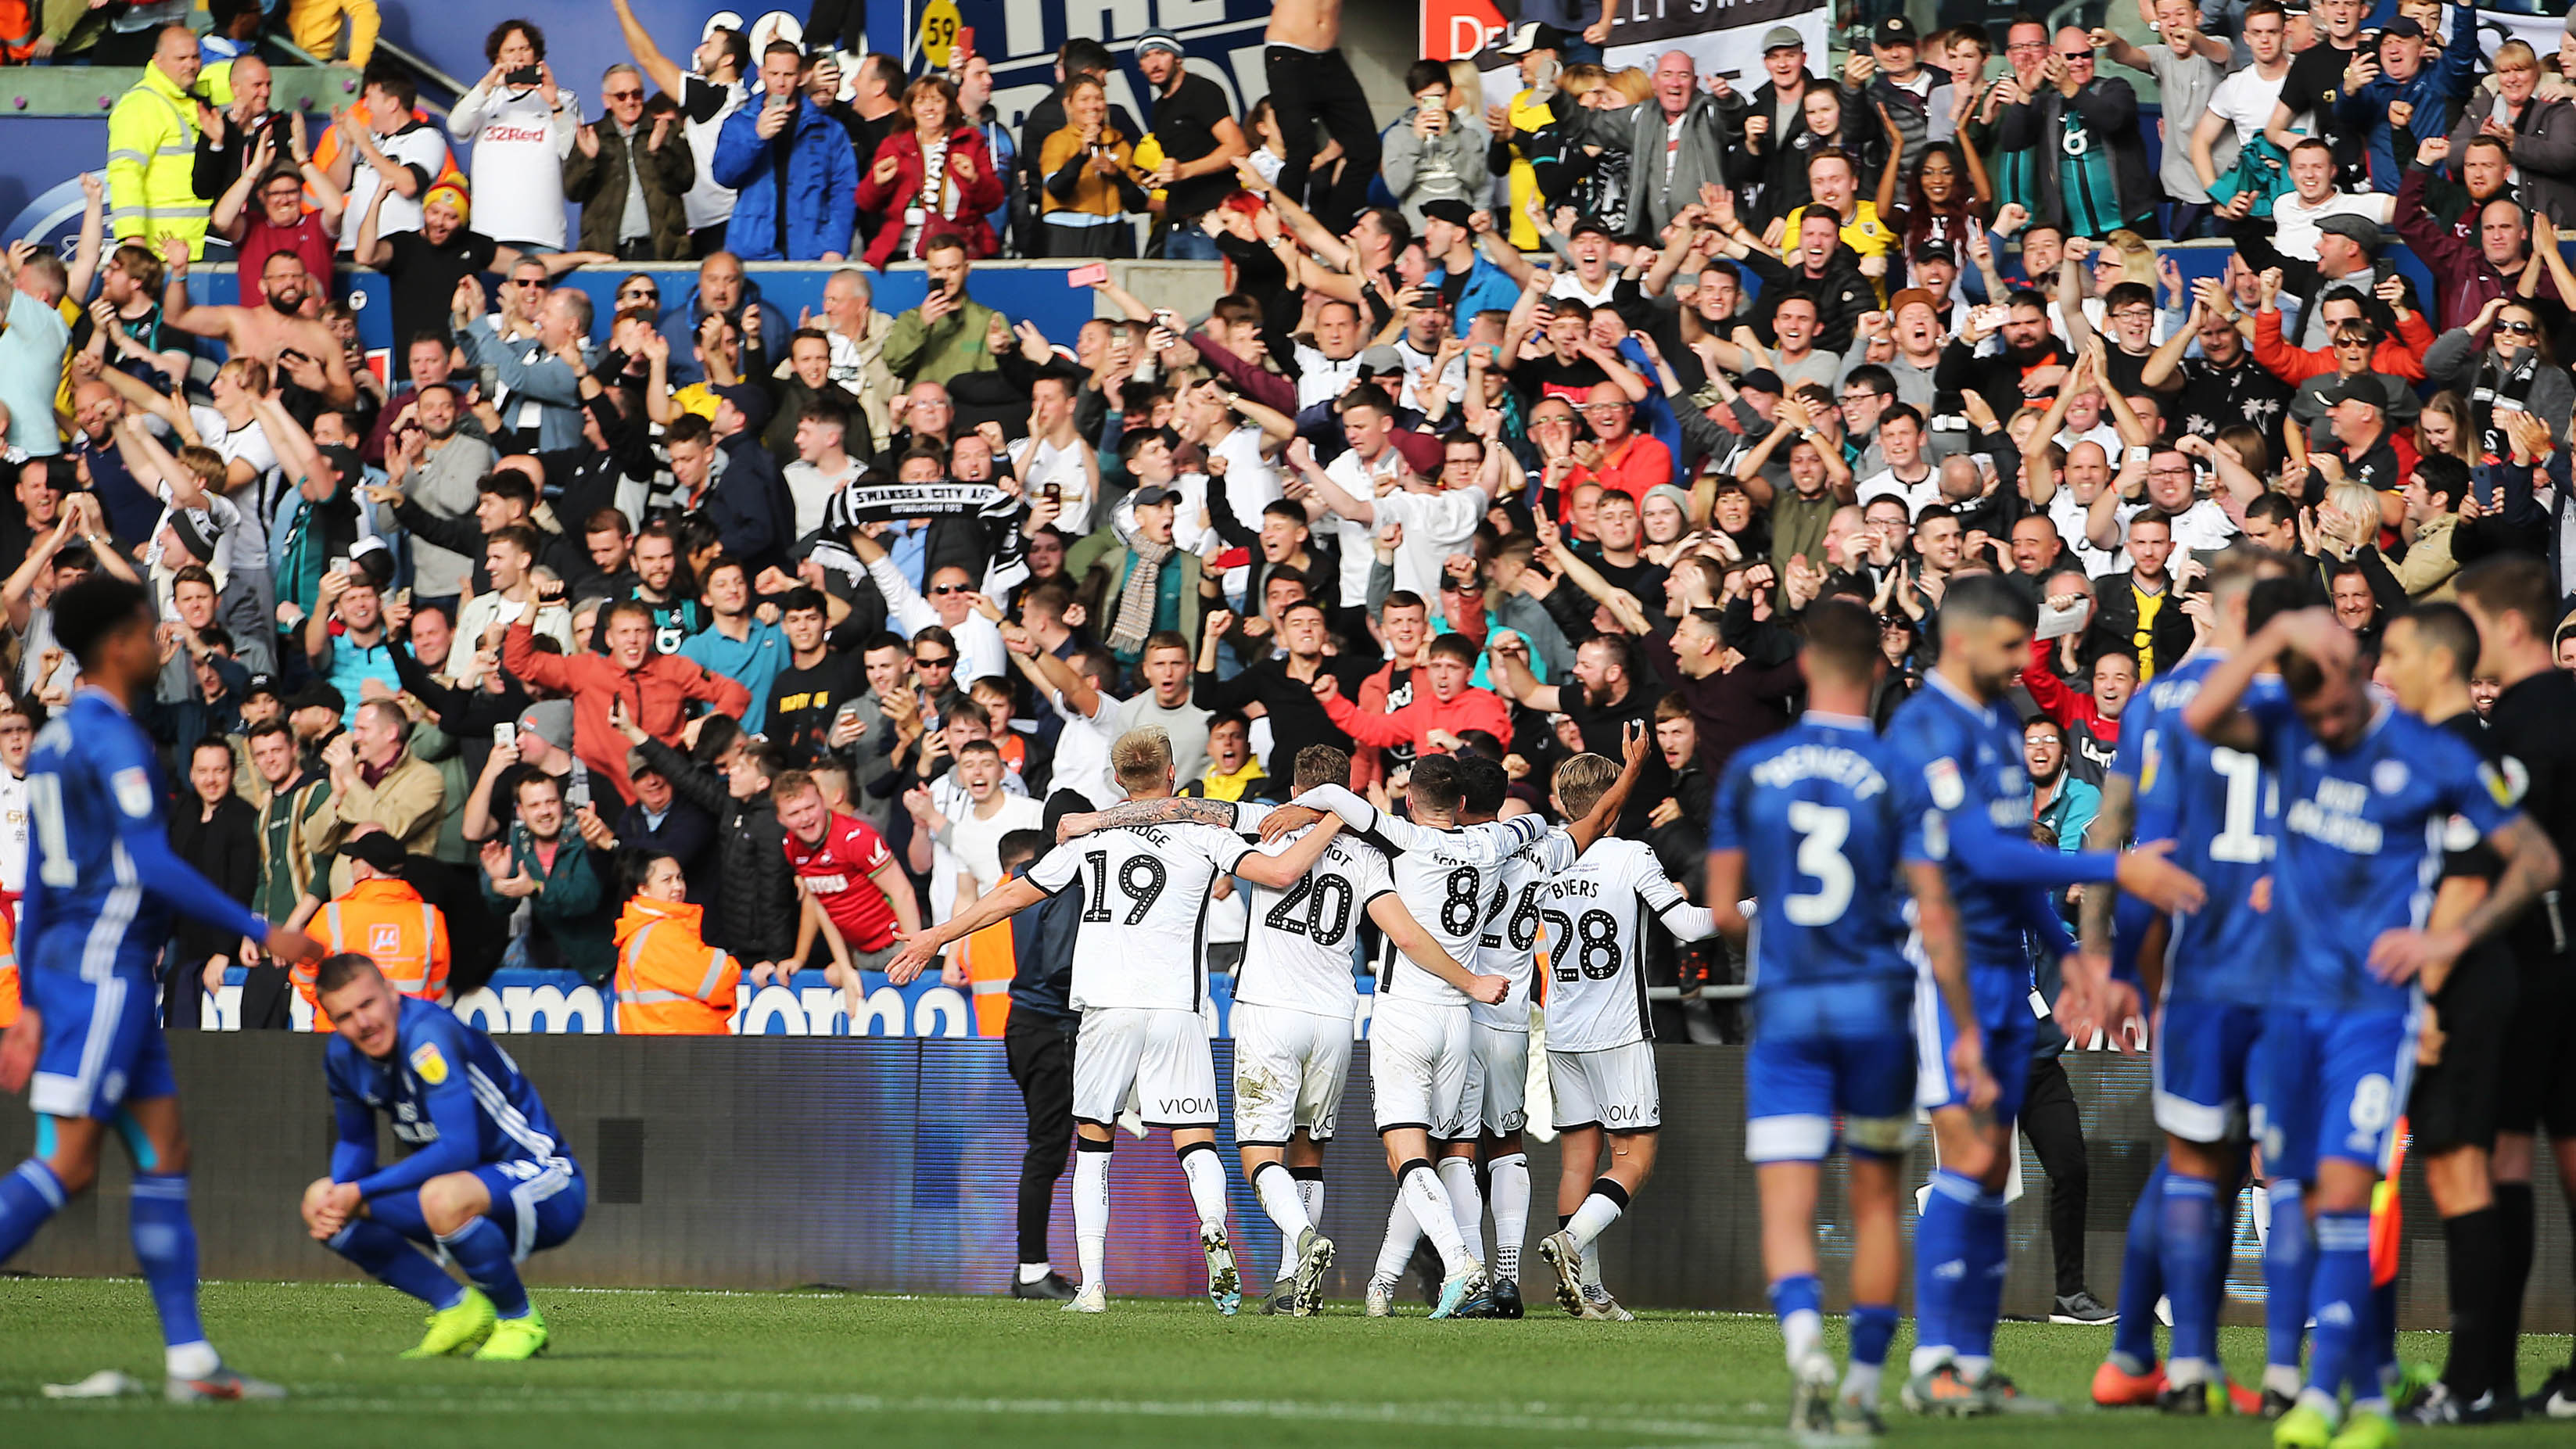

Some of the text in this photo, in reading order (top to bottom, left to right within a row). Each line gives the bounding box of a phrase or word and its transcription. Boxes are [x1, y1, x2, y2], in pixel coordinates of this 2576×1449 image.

[928, 18, 955, 47] 59
[485, 126, 545, 142] 32Red
[856, 488, 924, 503] SWANSEA
[931, 487, 963, 500] CITY
[1083, 850, 1167, 925] 19
[1552, 879, 1599, 900] BYERS
[1783, 800, 1856, 927] 3
[1265, 870, 1354, 946] 20
[1441, 866, 1480, 937] 8
[1477, 880, 1544, 952] 26
[1541, 909, 1622, 982] 28
[1159, 1097, 1215, 1114] VIOLA
[2348, 1072, 2391, 1131] 8
